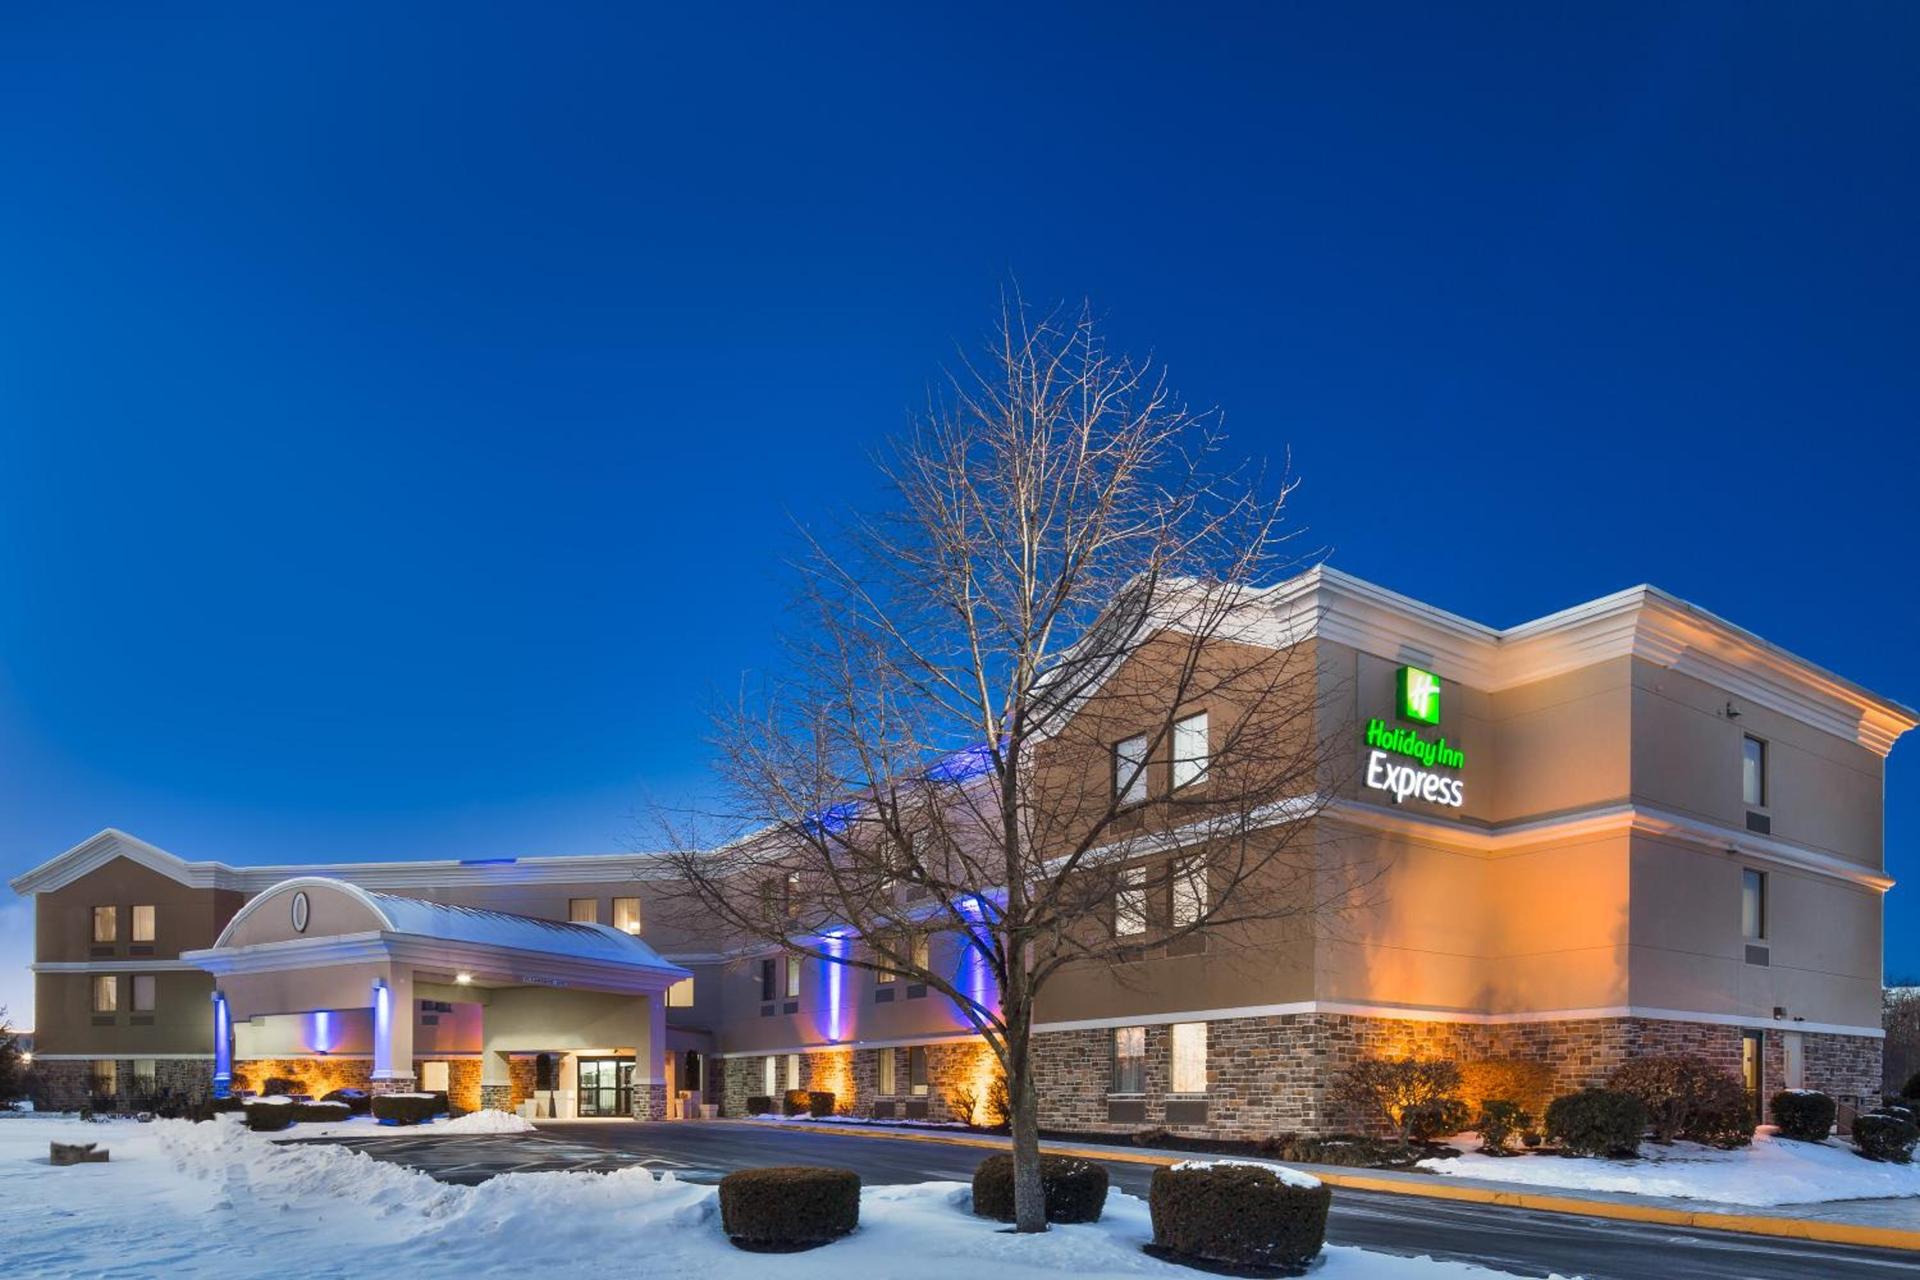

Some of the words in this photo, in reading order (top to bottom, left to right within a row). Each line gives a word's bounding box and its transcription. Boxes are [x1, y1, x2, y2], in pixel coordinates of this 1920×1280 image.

[1367, 717, 1437, 767] Holiday
[1437, 737, 1465, 769] Inn
[1366, 749, 1465, 809] Express
